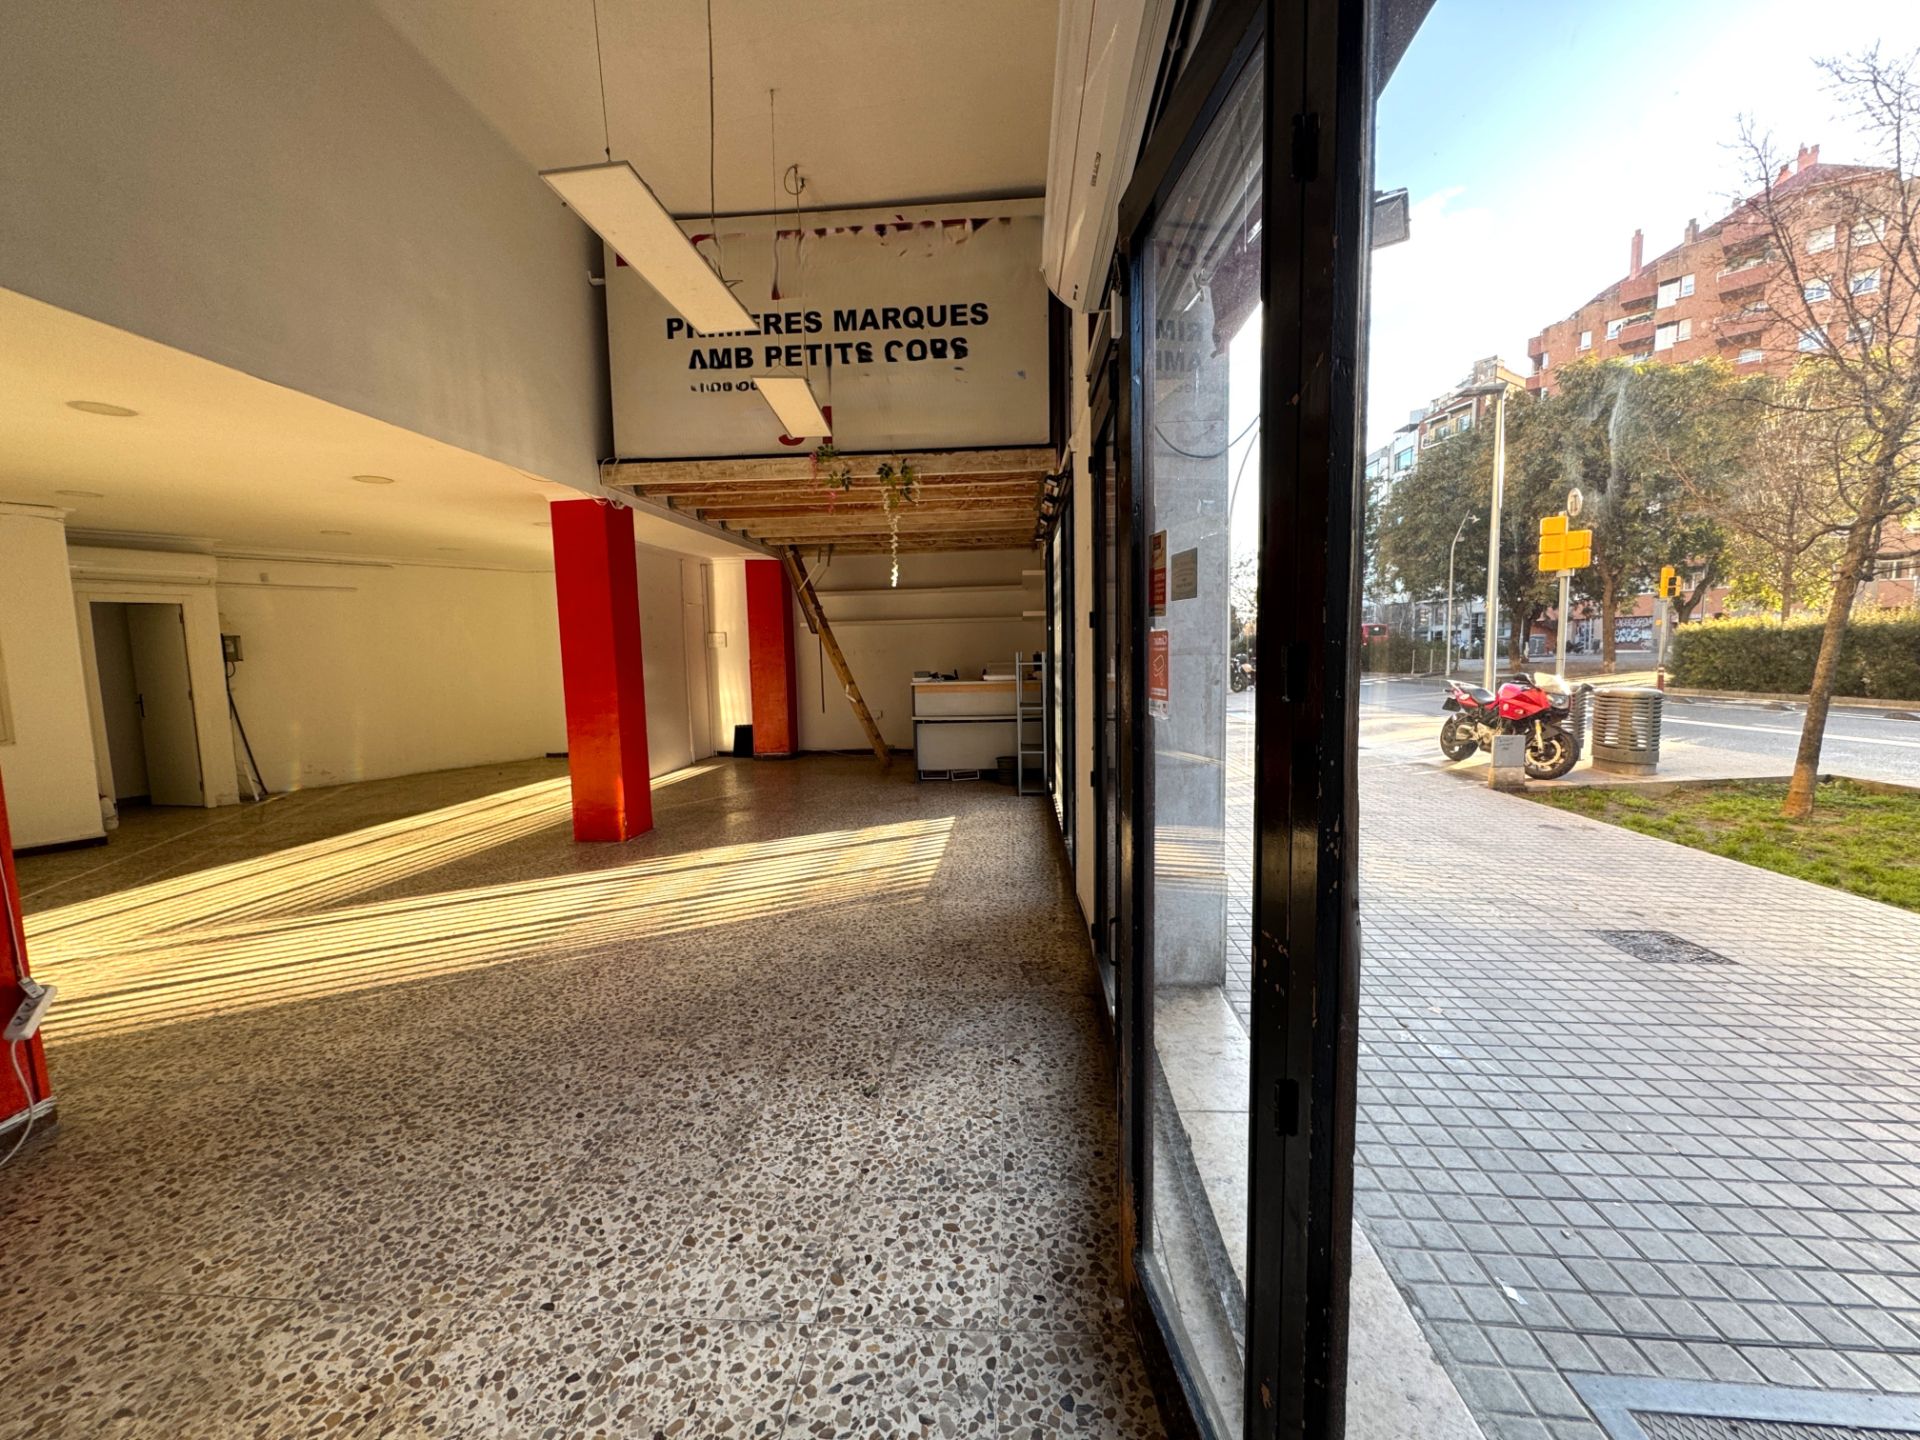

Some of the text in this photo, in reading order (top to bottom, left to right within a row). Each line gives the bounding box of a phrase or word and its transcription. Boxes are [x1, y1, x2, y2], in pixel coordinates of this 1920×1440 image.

[833, 303, 989, 332] MARQUES
[689, 347, 754, 369] AMB
[765, 342, 874, 367] PETITS
